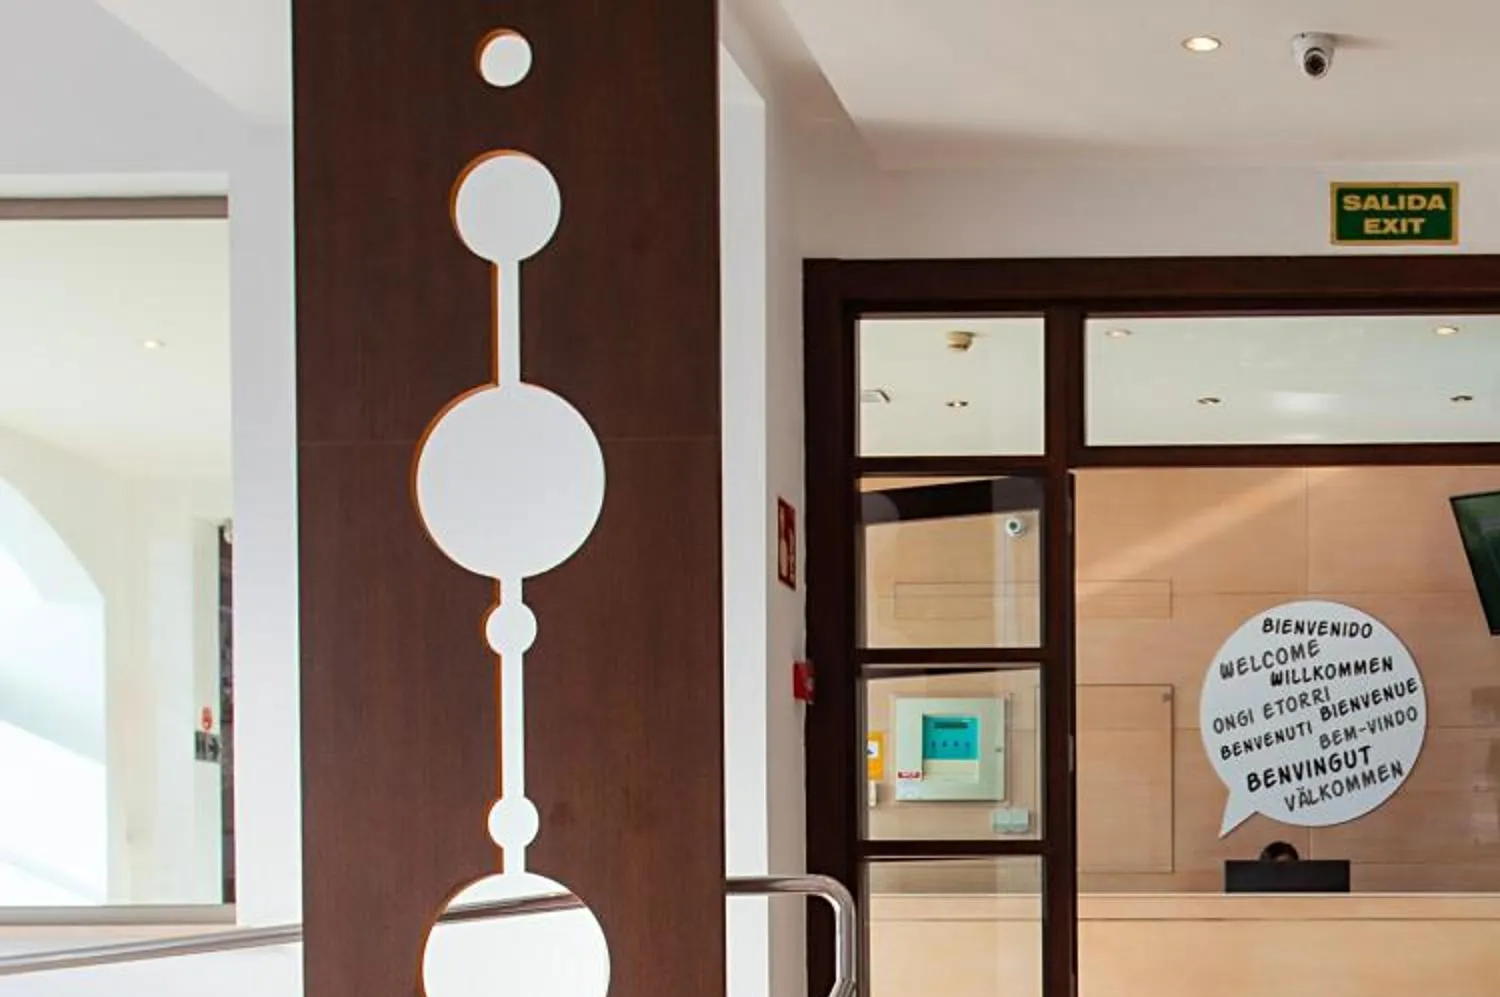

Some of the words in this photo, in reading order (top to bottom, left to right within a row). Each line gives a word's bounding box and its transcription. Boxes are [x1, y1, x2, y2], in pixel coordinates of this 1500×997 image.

[1343, 193, 1447, 211] SALIDA
[1363, 217, 1425, 235] EXIT
[1262, 617, 1373, 639] BIENVENIDO
[1219, 639, 1321, 680] WELCOME
[1270, 655, 1393, 687] WILLKOMMEN
[1213, 708, 1255, 735] ONGI
[1263, 686, 1331, 720] ETORRI
[1319, 677, 1418, 722] BIENVENUE
[1220, 721, 1313, 761] BENVENUTI
[1319, 706, 1418, 750] BEM-VINDO
[1246, 745, 1372, 792] BENVINGUT
[1284, 760, 1404, 812] VÄLKOMMEN
